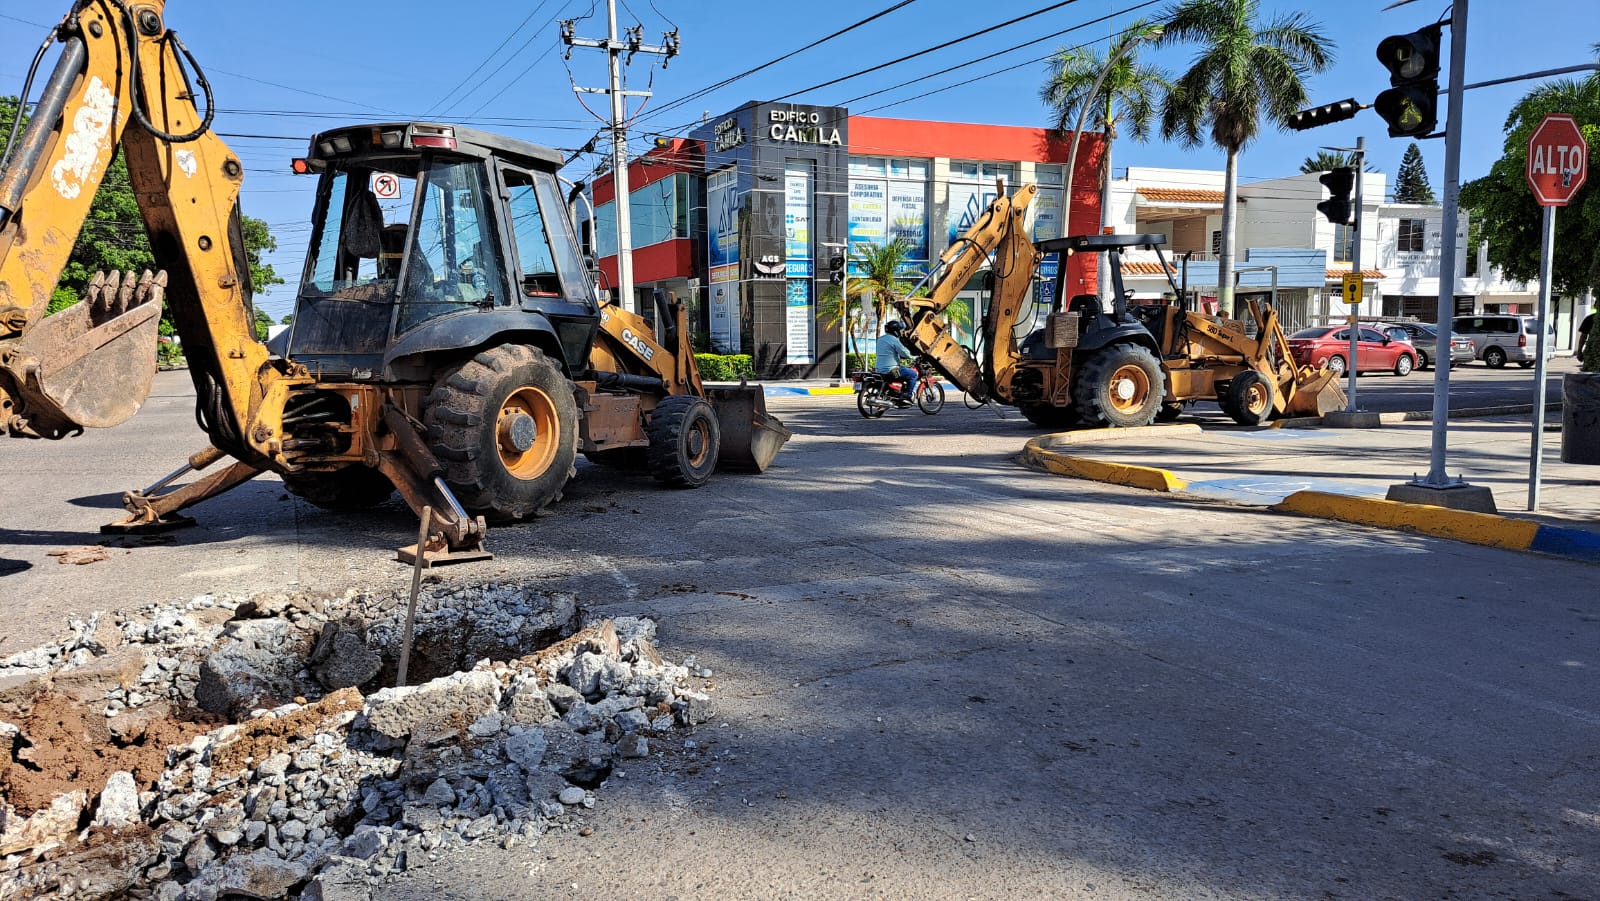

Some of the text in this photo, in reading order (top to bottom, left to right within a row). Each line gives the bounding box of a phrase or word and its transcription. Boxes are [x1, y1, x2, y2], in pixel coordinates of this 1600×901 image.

[770, 109, 820, 124] EDIFICIO
[1532, 144, 1583, 175] ALTO
[786, 263, 813, 274] SEGUROS
[1206, 324, 1218, 335] 580
[621, 329, 654, 361] CASE
